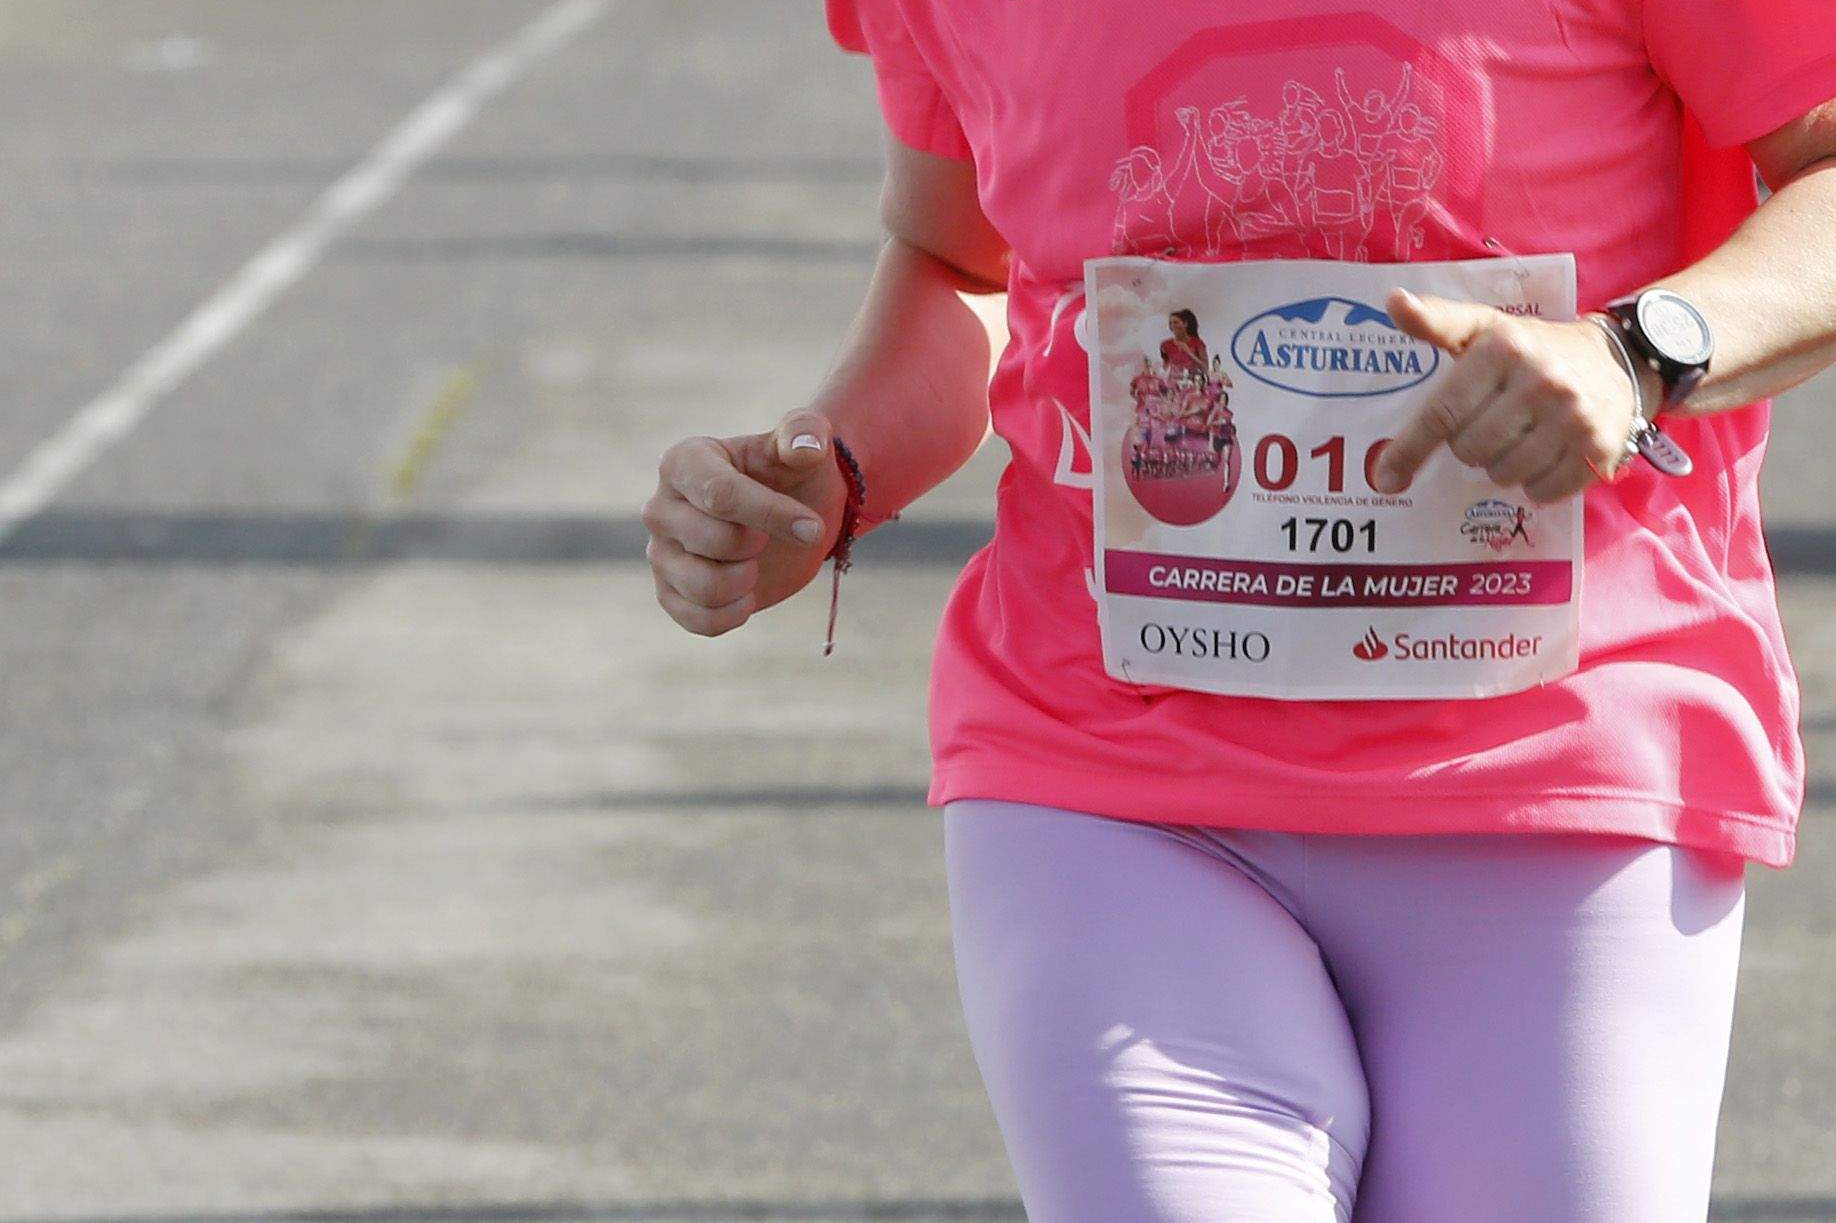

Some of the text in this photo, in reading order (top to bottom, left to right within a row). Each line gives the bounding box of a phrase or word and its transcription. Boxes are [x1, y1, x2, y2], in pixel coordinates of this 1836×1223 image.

[1248, 328, 1424, 375] ASTURIANA
[1278, 328, 1416, 346] CENTRAL LECHERA
[1251, 491, 1414, 508] TELÉFONO VIOLENCIA DE GÉNERO
[1280, 516, 1377, 554] 1701
[1148, 565, 1533, 598] CARRERA DE LA MUJER 2023
[1140, 621, 1271, 664] OYSHO
[1394, 631, 1543, 661] Santander
